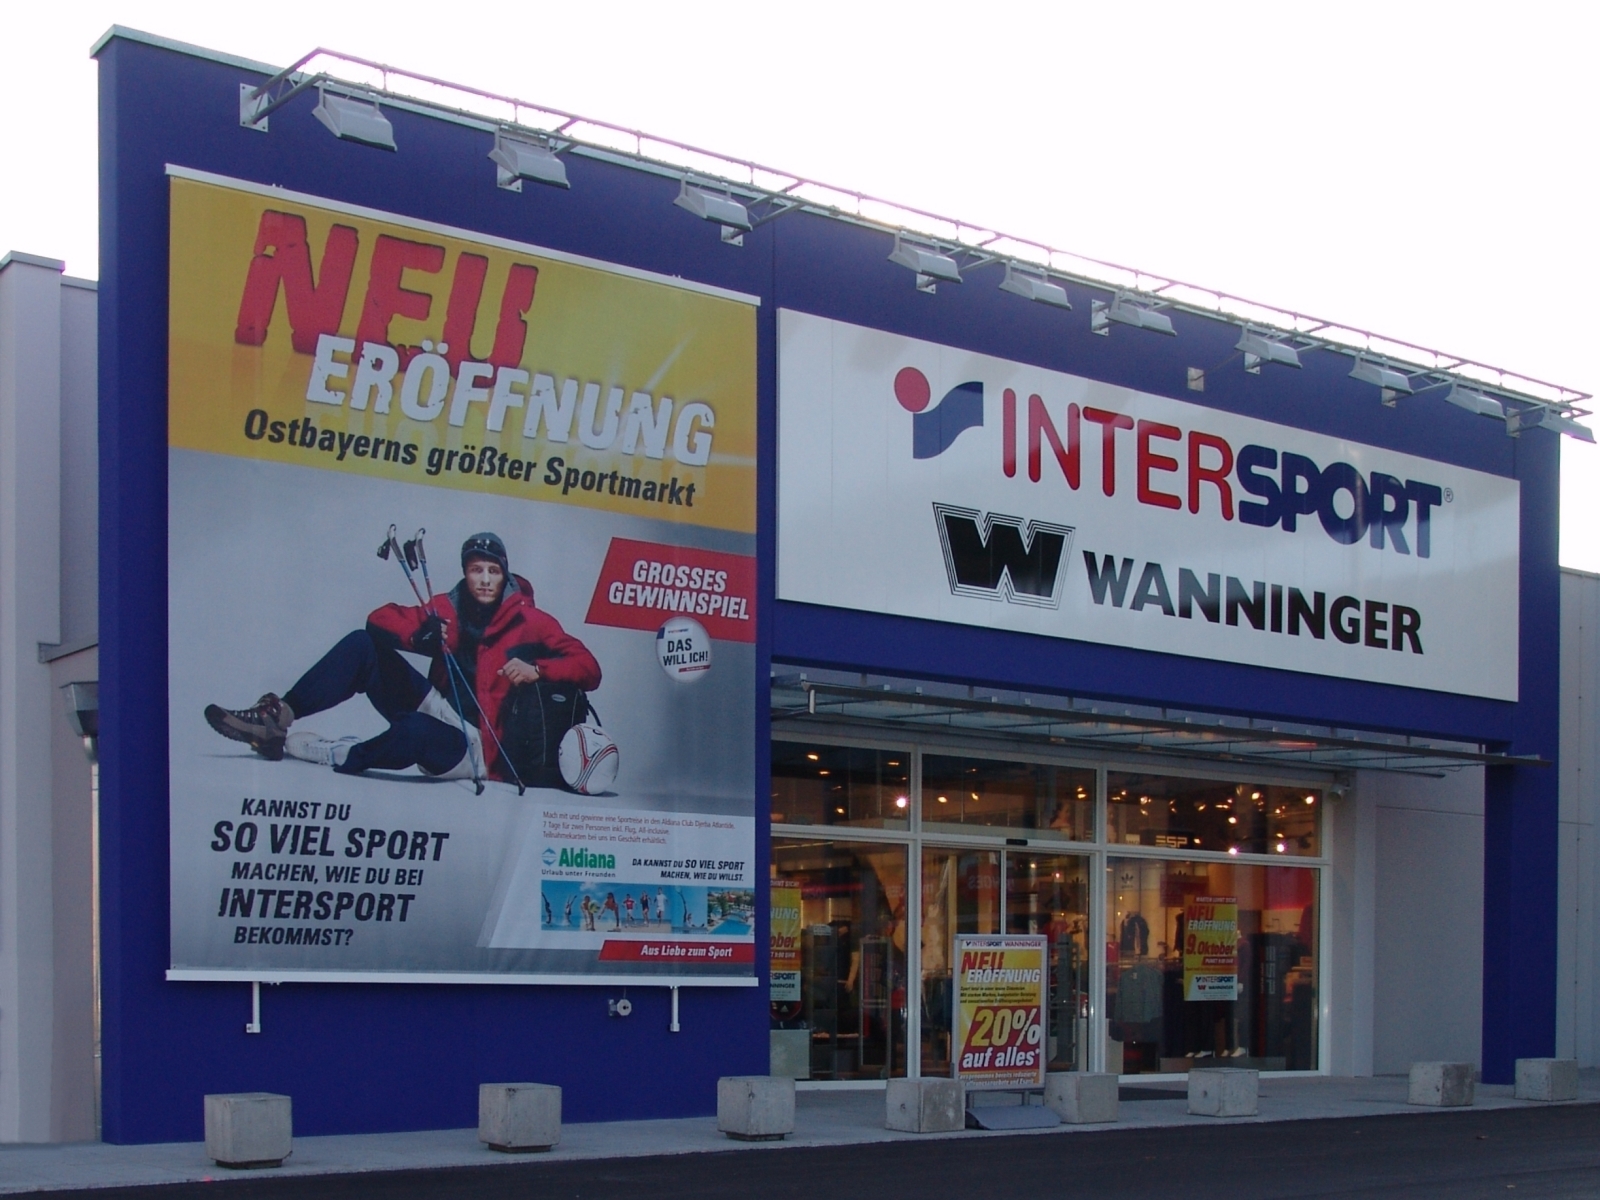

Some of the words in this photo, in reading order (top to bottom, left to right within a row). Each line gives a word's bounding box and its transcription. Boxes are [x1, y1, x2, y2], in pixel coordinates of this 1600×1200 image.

[234, 208, 539, 389] NEU
[305, 333, 717, 466] ERÖFFNUNG
[243, 407, 419, 465] Ostbayerns
[426, 445, 537, 484] größter
[543, 456, 697, 508] Sportmarkt
[1002, 387, 1443, 559] INTERSPORT
[632, 559, 728, 593] GROSSES
[608, 581, 750, 620] GEWINNSPIEL
[1082, 550, 1424, 655] WANNINGER
[667, 637, 692, 653] DAS
[662, 653, 687, 667] WILL
[689, 650, 709, 664] ICH!
[241, 797, 322, 819] KANNST
[324, 803, 351, 821] DU
[542, 811, 559, 821] Mach
[569, 813, 580, 822] und
[651, 816, 661, 825] den
[681, 818, 694, 827] Club
[542, 821, 548, 829] 7
[548, 821, 562, 831] Tage
[562, 822, 570, 830] für
[571, 823, 584, 831] zwei
[585, 823, 611, 832] Personen
[587, 832, 597, 841] bei
[598, 834, 608, 842] uns
[609, 834, 617, 842] im
[211, 820, 258, 853] SO
[270, 823, 335, 857] VIEL
[344, 827, 450, 861] SPORT
[558, 847, 616, 869] Aldiana
[632, 858, 643, 867] DA
[643, 858, 672, 868] KANNST
[673, 860, 684, 869] DU
[684, 859, 697, 869] SO
[699, 860, 716, 870] VIEL
[718, 861, 745, 871] SPORT
[231, 861, 319, 885] MACHEN,
[325, 865, 361, 884] WIE
[365, 867, 390, 886] DU
[394, 868, 424, 886] BEI
[541, 869, 564, 877] Urlaub
[660, 870, 692, 881] MACHEN,
[693, 872, 707, 880] WIE
[708, 872, 718, 881] DU
[719, 873, 744, 882] WILLST.
[218, 887, 416, 922] INTERSPORT
[1186, 904, 1215, 921] NEU
[233, 925, 354, 946] BEKOMMST?
[1188, 919, 1236, 931] ERÖFFNUNG
[770, 932, 797, 949] ober
[1197, 941, 1235, 956] Oktober
[641, 944, 660, 956] Aus
[661, 945, 686, 957] Liebe
[687, 948, 707, 957] zum
[708, 947, 732, 959] Sport
[961, 951, 1005, 974] NEU
[770, 972, 797, 981] RSPORT
[966, 967, 1041, 983] ERÖFFNUNG
[970, 1007, 1041, 1047] 20%
[962, 1047, 993, 1069] auf
